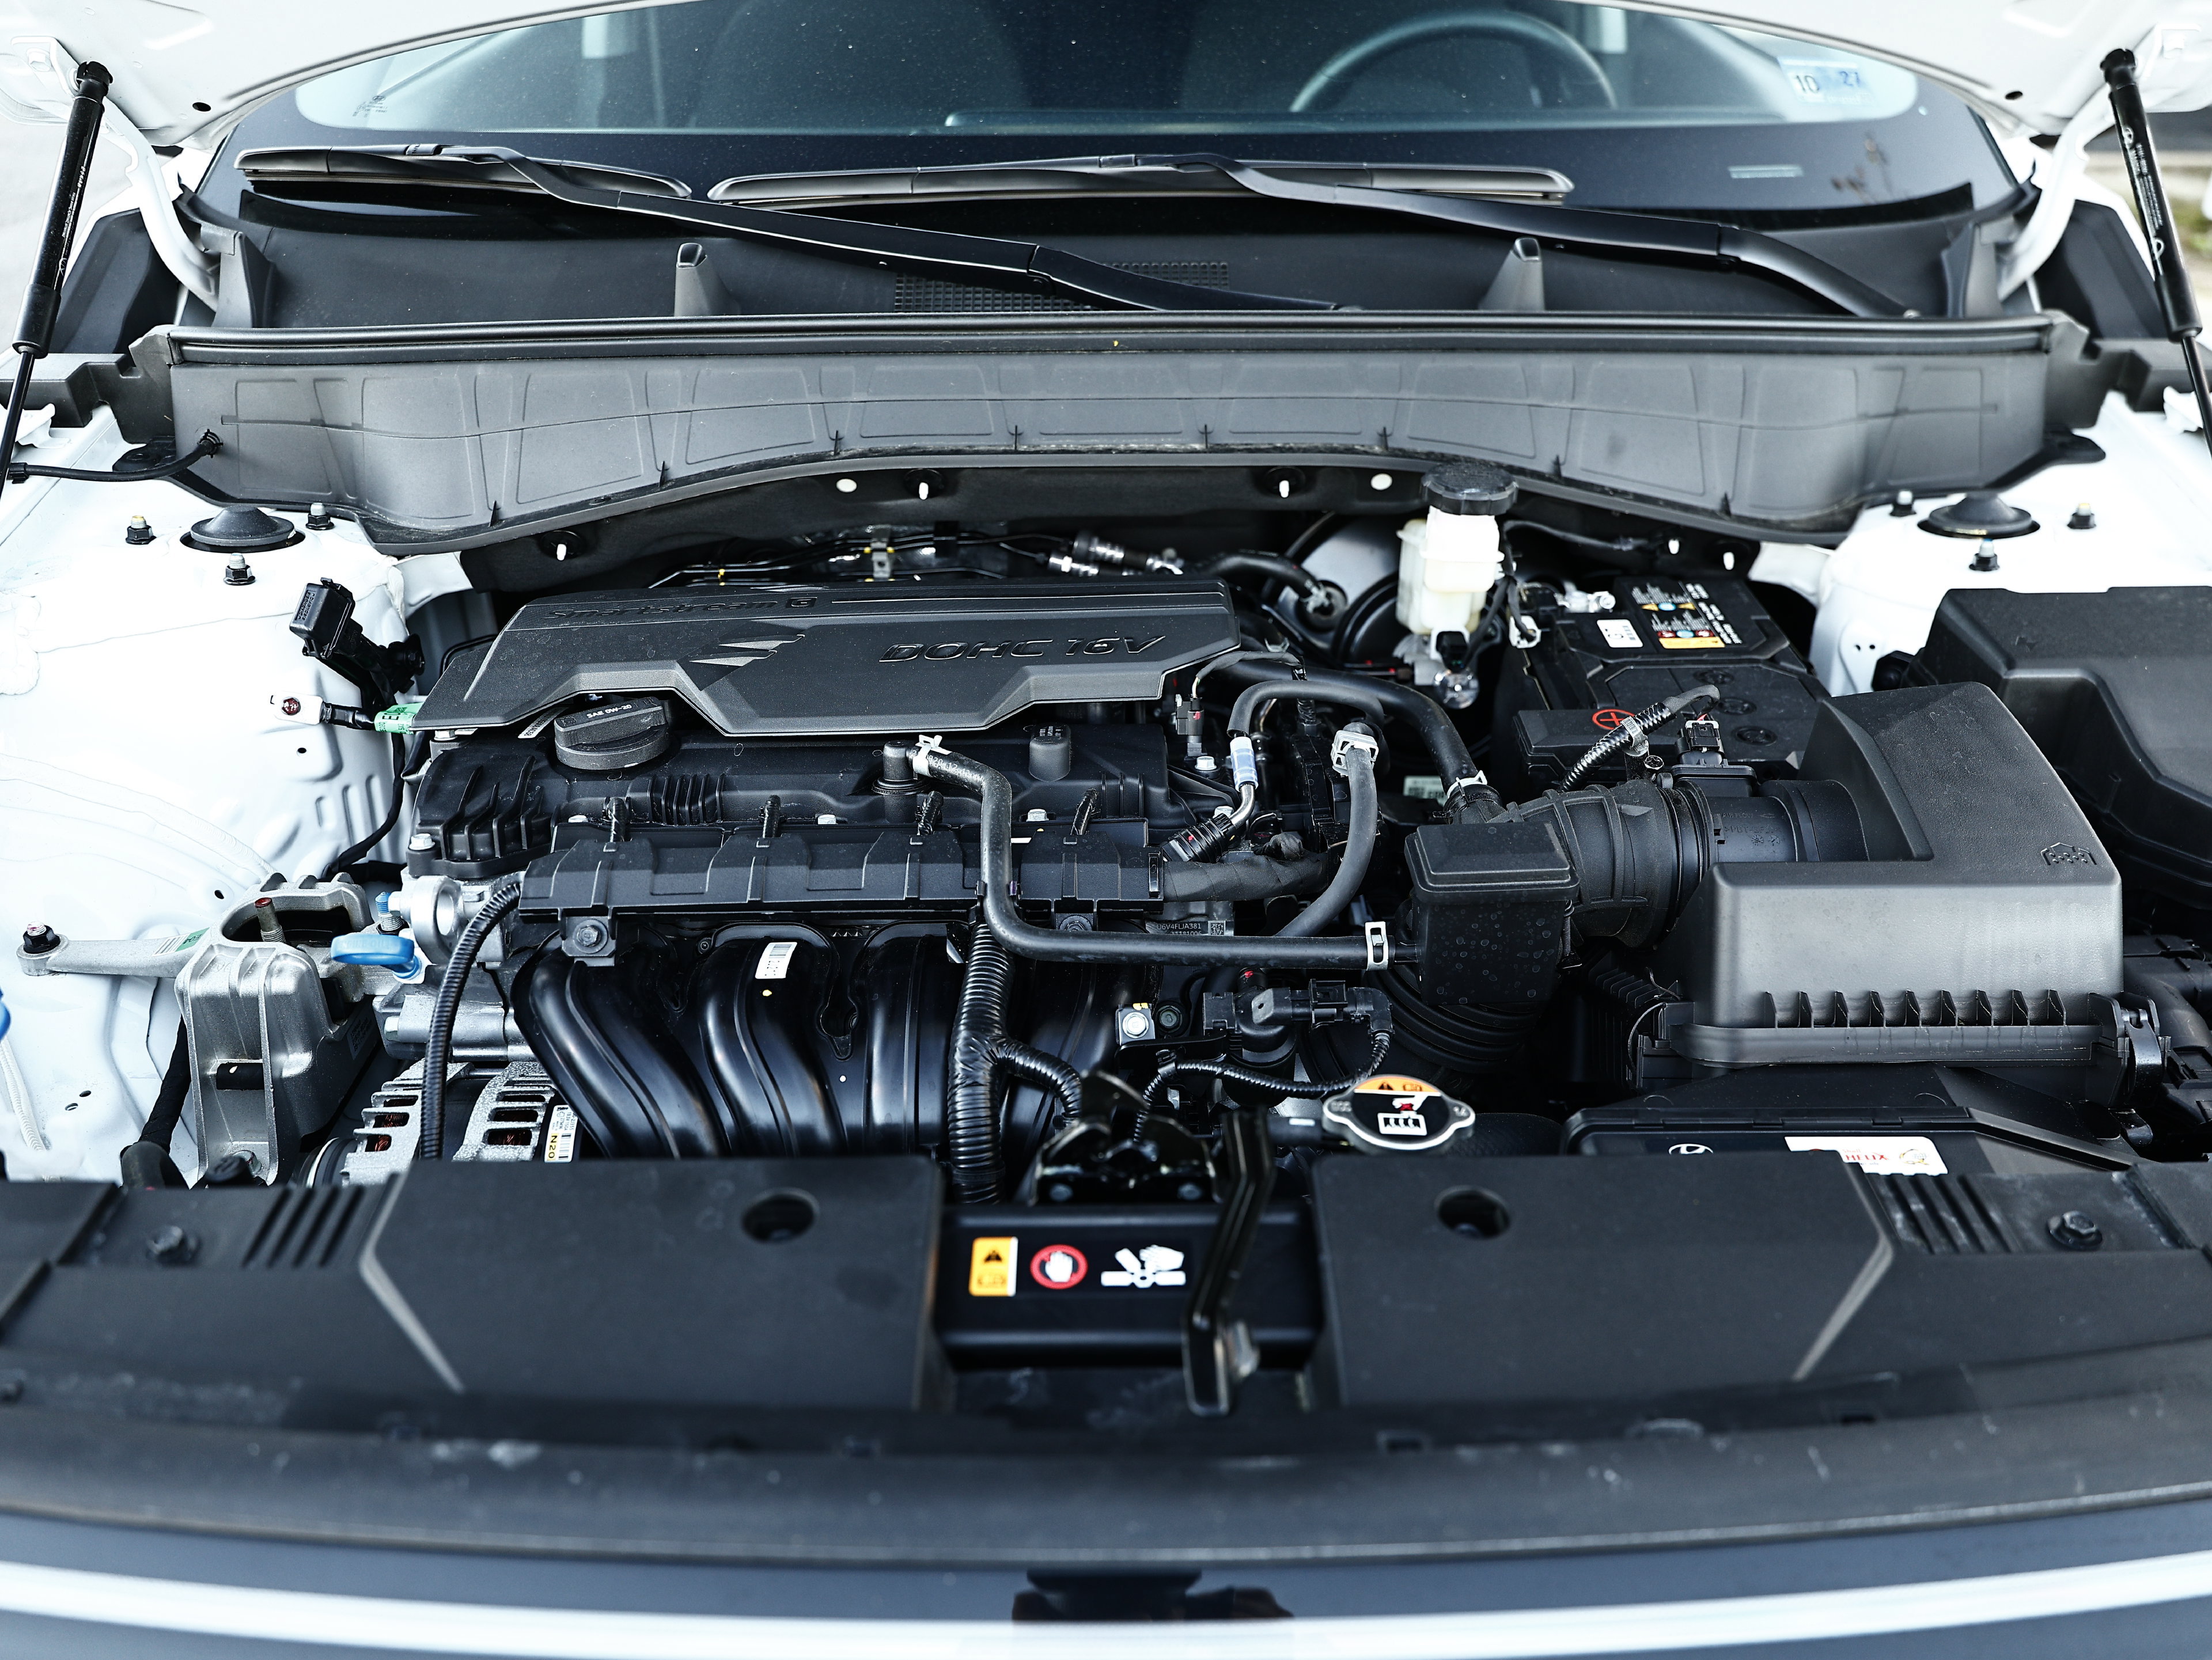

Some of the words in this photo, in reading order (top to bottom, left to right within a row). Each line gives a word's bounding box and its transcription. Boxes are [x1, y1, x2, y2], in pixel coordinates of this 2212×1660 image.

[1795, 74, 1820, 94] 10
[878, 639, 1053, 662] DOHC
[1065, 635, 1166, 656] 16V
[605, 704, 632, 714] 0W-20
[548, 1135, 558, 1158] N20
